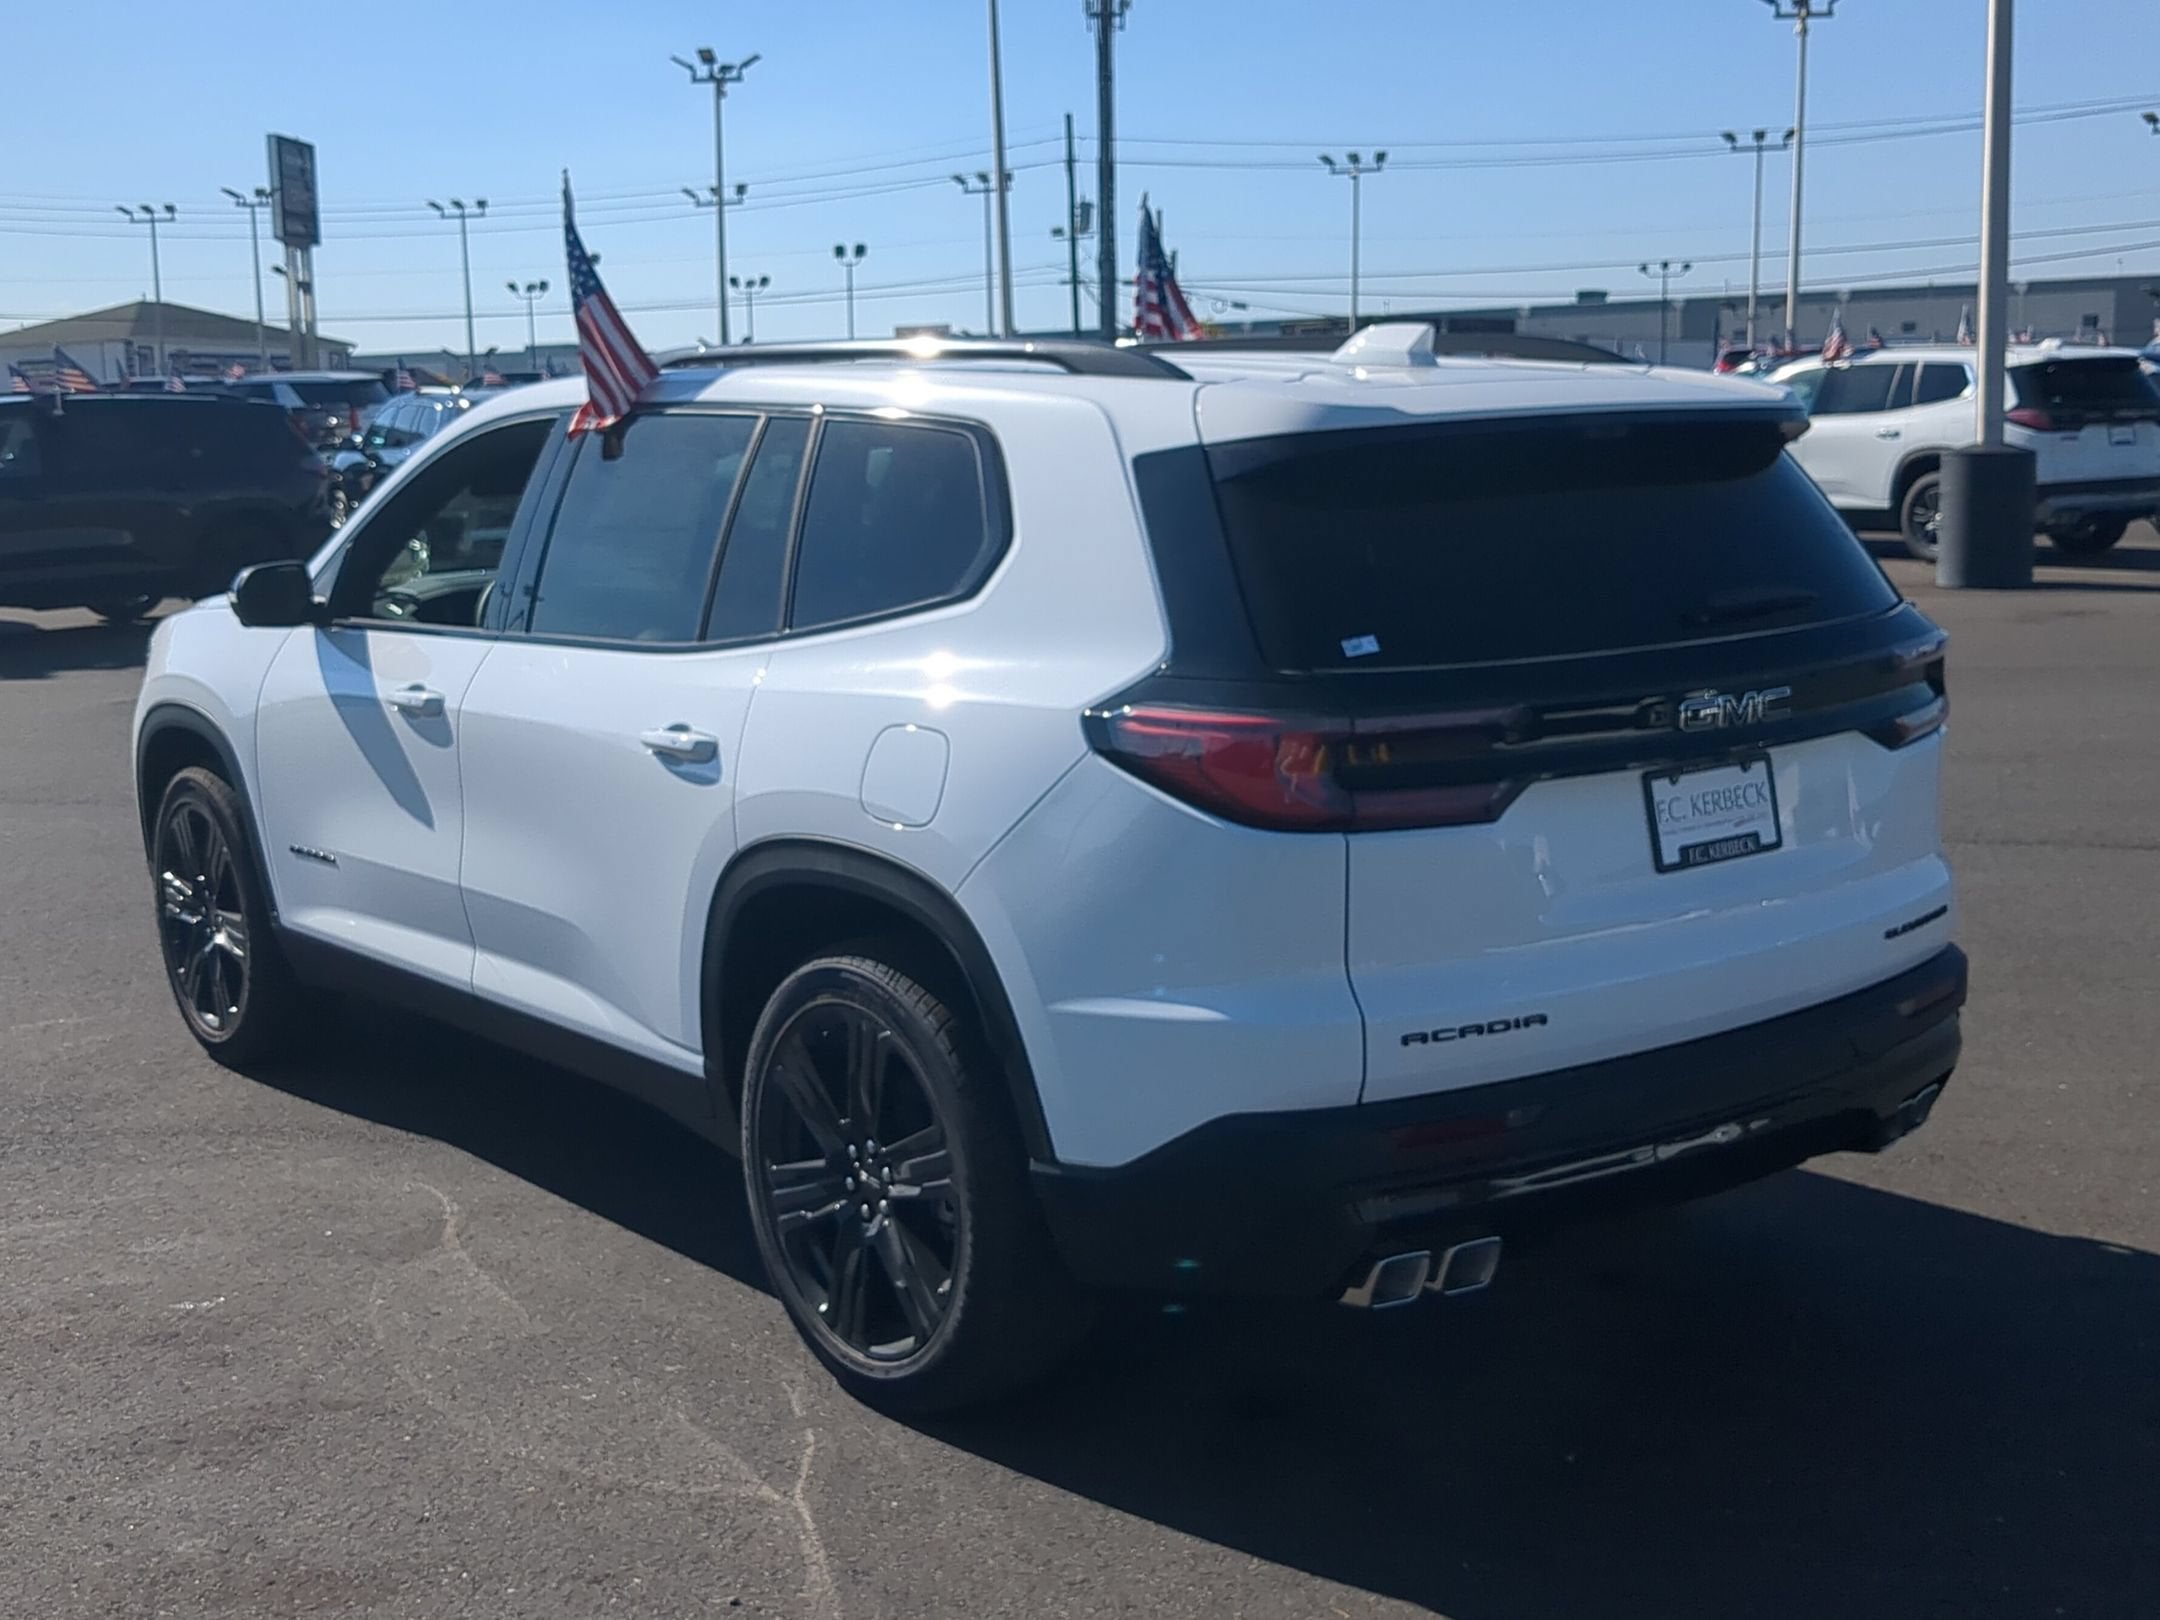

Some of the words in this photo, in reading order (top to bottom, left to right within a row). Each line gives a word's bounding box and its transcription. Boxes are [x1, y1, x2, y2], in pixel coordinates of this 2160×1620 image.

[1679, 686, 1791, 733] GMC
[1657, 796, 1686, 823] F.C.
[1690, 781, 1768, 817] KERBECK
[1708, 837, 1755, 859] KERBECK
[1401, 1013, 1548, 1046] ACADIA
